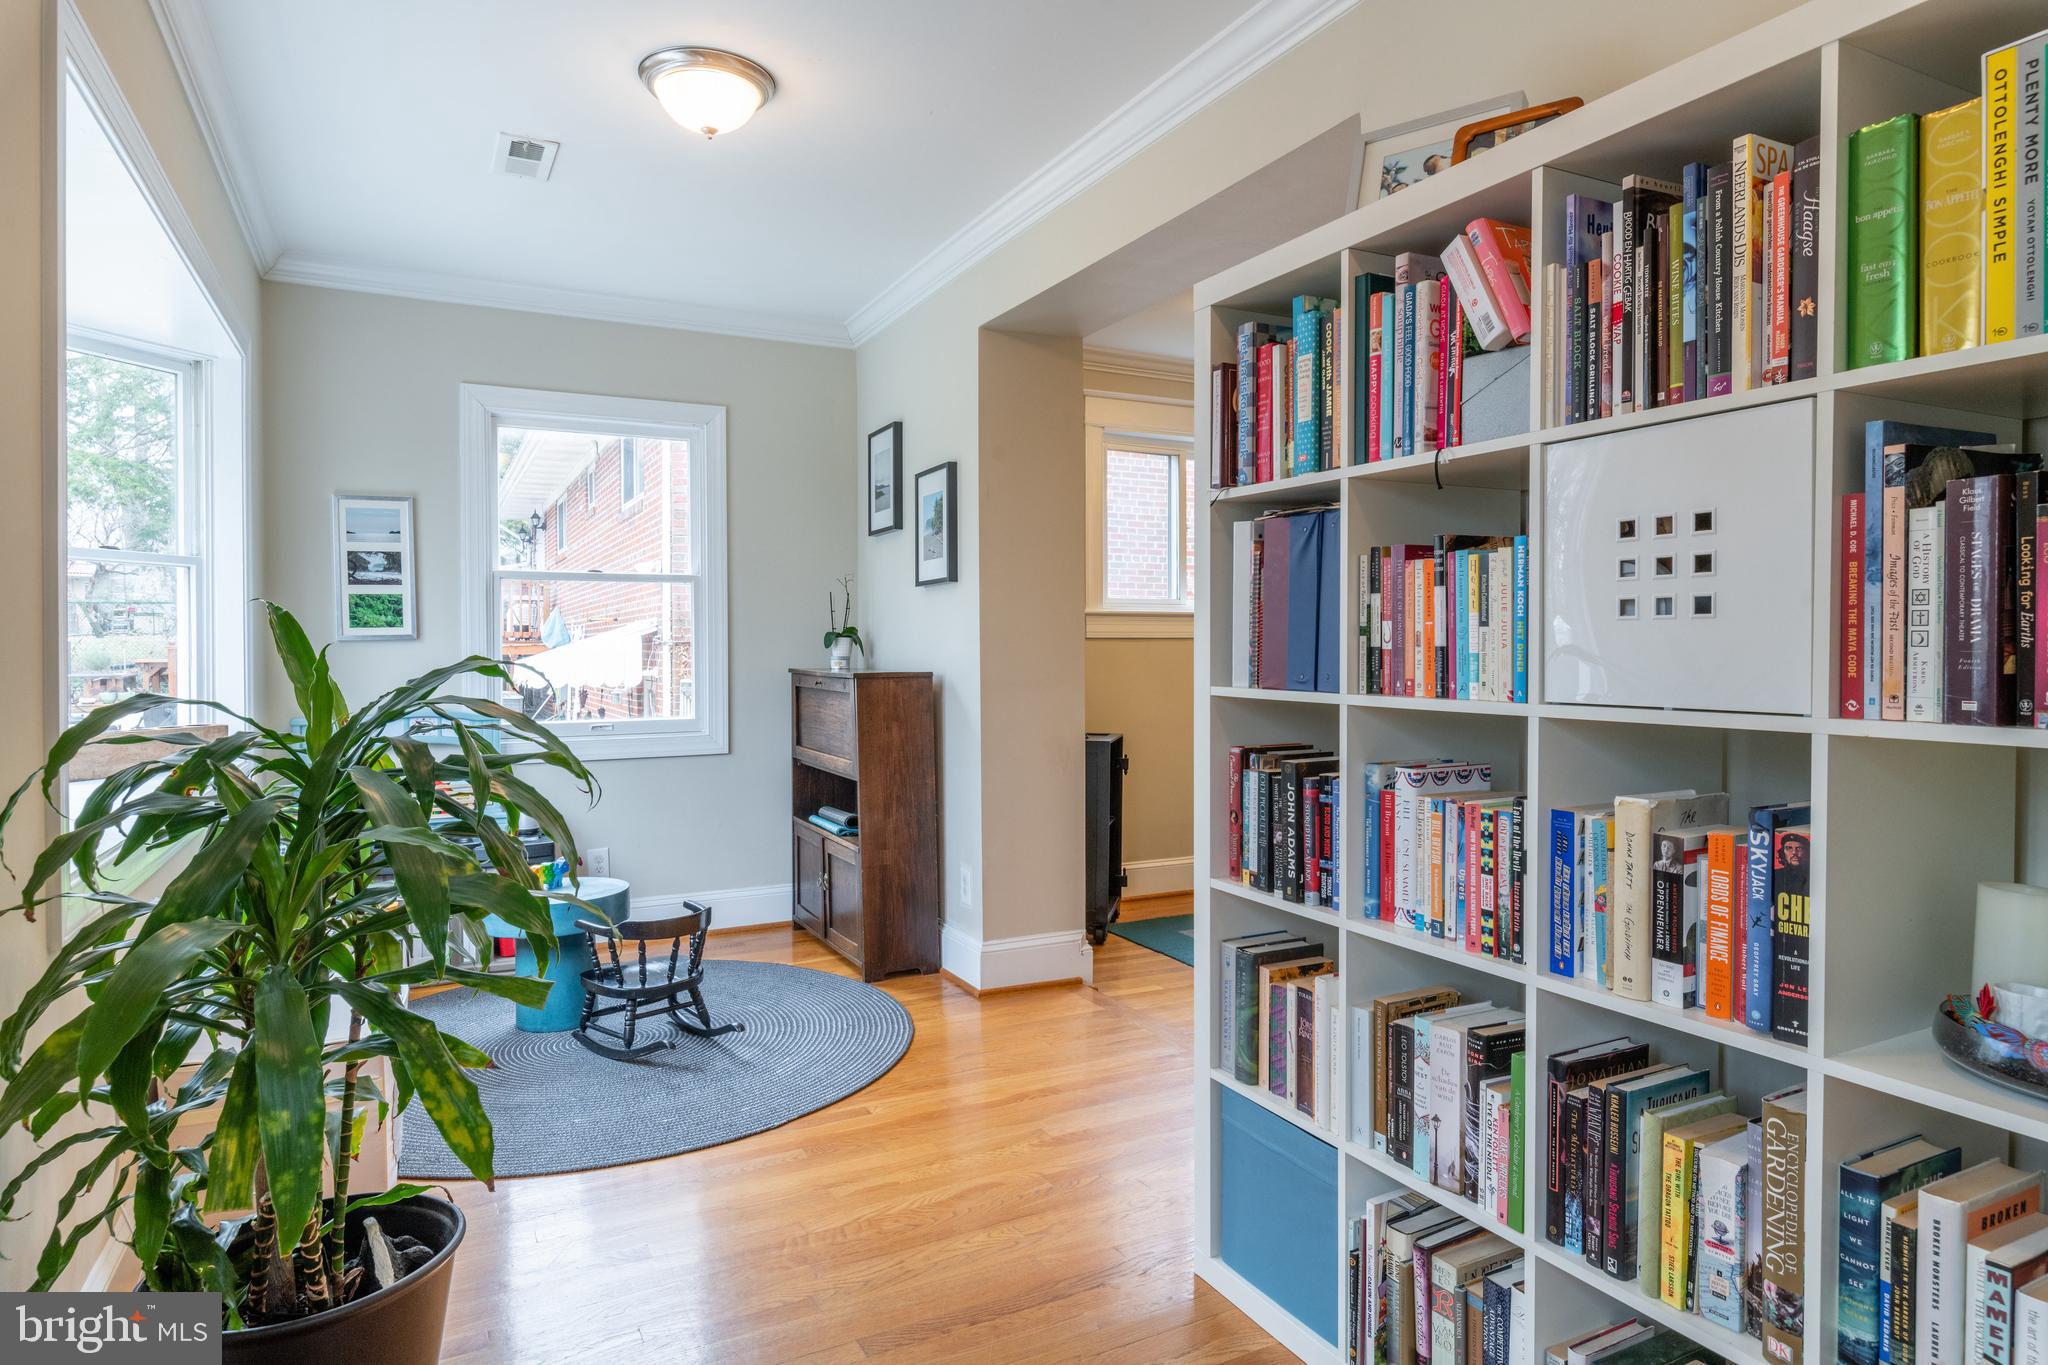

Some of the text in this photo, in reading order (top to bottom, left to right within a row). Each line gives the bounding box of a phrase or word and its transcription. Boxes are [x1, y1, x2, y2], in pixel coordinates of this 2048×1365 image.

[2025, 59, 2040, 187] PLENTY MORE
[1757, 143, 1789, 174] SPA
[1993, 70, 2008, 265] OTTOLENGHI SIMPLE
[1714, 189, 1722, 209] From
[1733, 160, 1747, 268] NEERLANDS DIS
[1777, 197, 1786, 245] GREENHOUSE
[1714, 218, 1722, 242] Polish
[1796, 191, 1820, 257] Haagse
[1623, 211, 1633, 313] BROOD EN HARTIG GEBAK
[1714, 243, 1722, 276] Country
[1777, 246, 1786, 293] GARDENER'S
[1926, 251, 1980, 269] COOKBOOK
[2026, 200, 2036, 302] YOTAM OTTOLENGHI
[1672, 259, 1680, 326] WINE BITES
[1714, 277, 1722, 300] House
[1865, 268, 1890, 281] fresh
[1404, 291, 1413, 325] GIADA'S
[1440, 310, 1447, 319] AT
[1714, 302, 1722, 334] Kitchen
[1777, 294, 1786, 326] MANUAL
[1404, 325, 1413, 343] FEEL
[1404, 344, 1413, 365] GOOD
[1573, 297, 1582, 369] SALT BLOCK
[1602, 315, 1611, 375] world breads
[1325, 323, 1333, 418] COOK with JAMIE
[1404, 366, 1413, 388] FOOD
[1588, 308, 1596, 405] SALT BLOCK GRILLING
[1239, 334, 1250, 459] het basiskookboek
[1370, 359, 1378, 439] HAPPY cooking
[1912, 540, 1922, 580] OF GOD
[1922, 543, 1933, 585] HISTORY
[1959, 565, 1966, 573] TO
[1849, 561, 1858, 606] BREAKING
[1888, 553, 1901, 633] Images of the Past
[1970, 531, 1983, 644] STAGES DRAMA
[2018, 536, 2034, 649] Looking for Earths
[1517, 545, 1525, 673] HERMAN KOCH HET DINER
[1849, 608, 1858, 625] THE
[1849, 628, 1858, 652] MAYA
[1849, 653, 1858, 679] CODE
[1287, 782, 1296, 880] JOHN ADAMS
[1431, 819, 1441, 835] BILL
[1513, 806, 1522, 872] Talk of the Devil
[1431, 836, 1441, 865] BRYSON
[1750, 830, 1769, 901] SKYJACK
[1459, 869, 1467, 900] Op reis
[1656, 880, 1665, 950] OPPENHEIMER
[1709, 869, 1729, 964] LORDS OF FINANCE
[1753, 942, 1761, 997] GEOFFREY GRAY
[1487, 1120, 1493, 1131] OF
[1609, 1093, 1620, 1154] KHALED HOSSEINI
[1499, 1136, 1508, 1199] CAKE WRECKS
[1569, 1111, 1579, 1197] THE MINIATURIST
[1765, 1117, 1786, 1276] GARDENING
[1784, 1133, 1799, 1274] ENCYCLOPEDIA OF
[1840, 1189, 1876, 1206] ALL THE
[1981, 1200, 2027, 1231] BROKEN
[1843, 1212, 1870, 1226] LIGHT
[1849, 1235, 1862, 1246] WE
[1840, 1253, 1876, 1271] CANNOT
[1848, 1278, 1864, 1289] SEE
[1932, 1219, 1941, 1359] BROKEN MONSTERS LAUREN
[1902, 1331, 1909, 1340] OF
[1985, 1270, 2008, 1357] MAMET
[2027, 1311, 2040, 1354] the art of
[1768, 1337, 1792, 1361] DK
